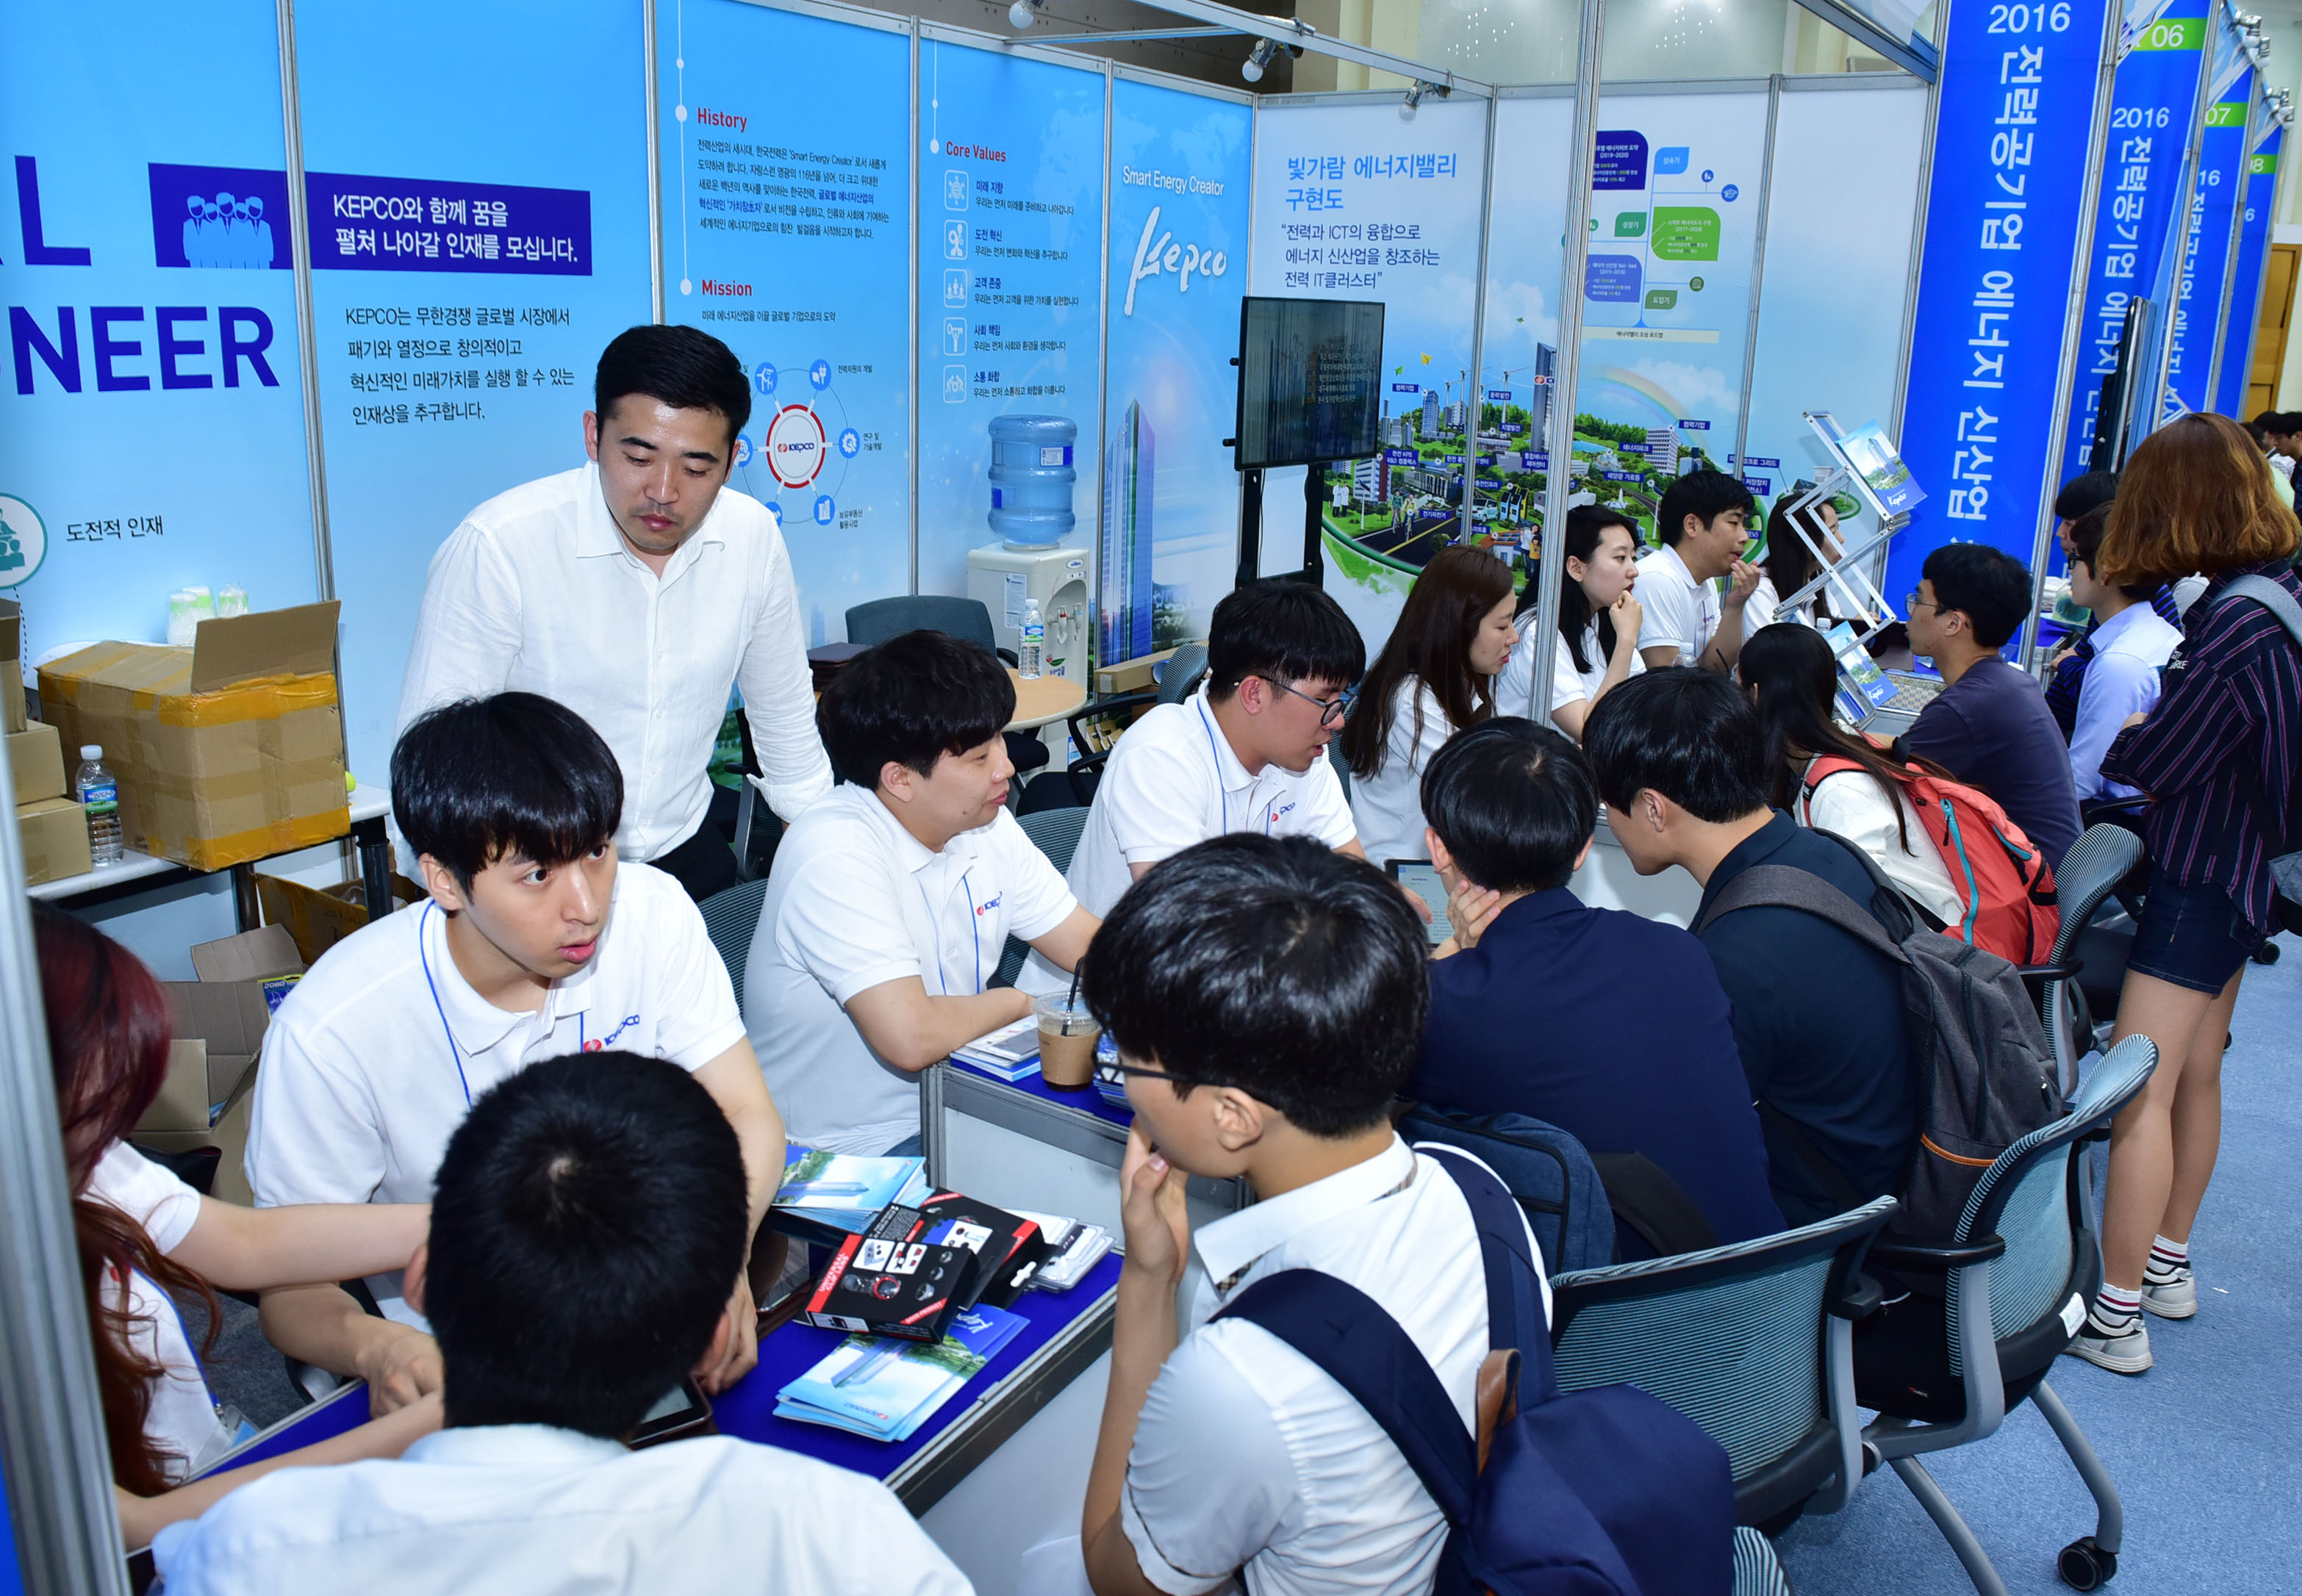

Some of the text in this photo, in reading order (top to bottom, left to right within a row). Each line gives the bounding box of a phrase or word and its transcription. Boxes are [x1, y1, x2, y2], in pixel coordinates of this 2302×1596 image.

[1987, 4, 2070, 34] 2016
[2151, 24, 2184, 48] 06
[698, 107, 747, 132] History
[2112, 107, 2170, 129] 2016
[2206, 107, 2231, 125] 07
[698, 139, 731, 153] 전력산업의
[756, 145, 788, 159] 한국전력은
[809, 152, 830, 165] Energy
[855, 157, 867, 168] 로서
[946, 141, 1006, 162] Core Values
[698, 159, 725, 173] 도약하려
[727, 161, 748, 175] 합니다.
[778, 166, 796, 179] 영광의
[839, 173, 845, 184] 더
[847, 174, 858, 184] 크고
[861, 175, 878, 187] 위대한
[1288, 153, 1457, 180] 빛가람 에너지밸리
[976, 180, 1003, 194] 미래 지향
[1122, 165, 1224, 196] Smart Energy Creator
[699, 179, 719, 191] 새로운
[720, 180, 740, 193] 백년의
[742, 182, 761, 195] 역사를
[819, 189, 836, 201] 글로벌
[839, 191, 874, 204] 에너지산업의
[1286, 187, 1344, 212] 구현도
[0, 155, 91, 266] L
[334, 193, 509, 227] KEPCO와 함께 꿈을
[699, 197, 725, 211] 혁신적인
[764, 204, 777, 215] 로서
[779, 204, 797, 216] 비전을
[827, 207, 845, 219] 인류와
[847, 209, 864, 221] 사회에
[867, 211, 889, 223] 기여하는
[976, 196, 1074, 215] 우리는 먼저 미래를 준비하고 나아갑니다
[2104, 136, 2152, 278] 전력공기업
[700, 217, 726, 230] 세계적인
[728, 219, 778, 233] 에너지기업으로의
[824, 226, 853, 237] 시작하고자
[975, 229, 1003, 242] 도전 혁신
[1329, 224, 1362, 241] ICT의
[1366, 224, 1421, 241] 융합으로
[336, 227, 578, 262] 펼쳐 나아갈 인재를 모십니다.
[975, 245, 1068, 261] 우리는 먼저 변화와 혁신을 추구합니다
[1286, 248, 1440, 266] 에너지 신산업을 창조하는
[702, 279, 752, 296] Mission
[975, 278, 1002, 290] 고객 존중
[1285, 271, 1309, 288] 전력
[1947, 44, 2043, 521] 전력공기업 에너지 신산업
[975, 294, 1078, 306] 우리는 먼저 고객을 위한 가치를 실현합니다
[346, 306, 570, 326] KEPCO는 무한경쟁 글로벌 시장에서
[702, 310, 836, 323] 미래 에너지산업을 이끌 글로벌 기업으로의 도약
[975, 324, 1000, 336] 사회 책임
[348, 338, 523, 359] 패기와 열정으로 창의적이고
[974, 341, 1066, 351] 우리는 먼저 사회와 환경을 생각합니다
[350, 367, 575, 392] 혁신적인 미래가치를 실행 할 수 있는
[974, 370, 1000, 383] 소통 화합
[973, 385, 1065, 398] 우리는 먼저 소통하고 화합을 이룹니다
[353, 401, 485, 425] 인재상을 추구합니다.
[65, 516, 163, 543] 도전적 인재
